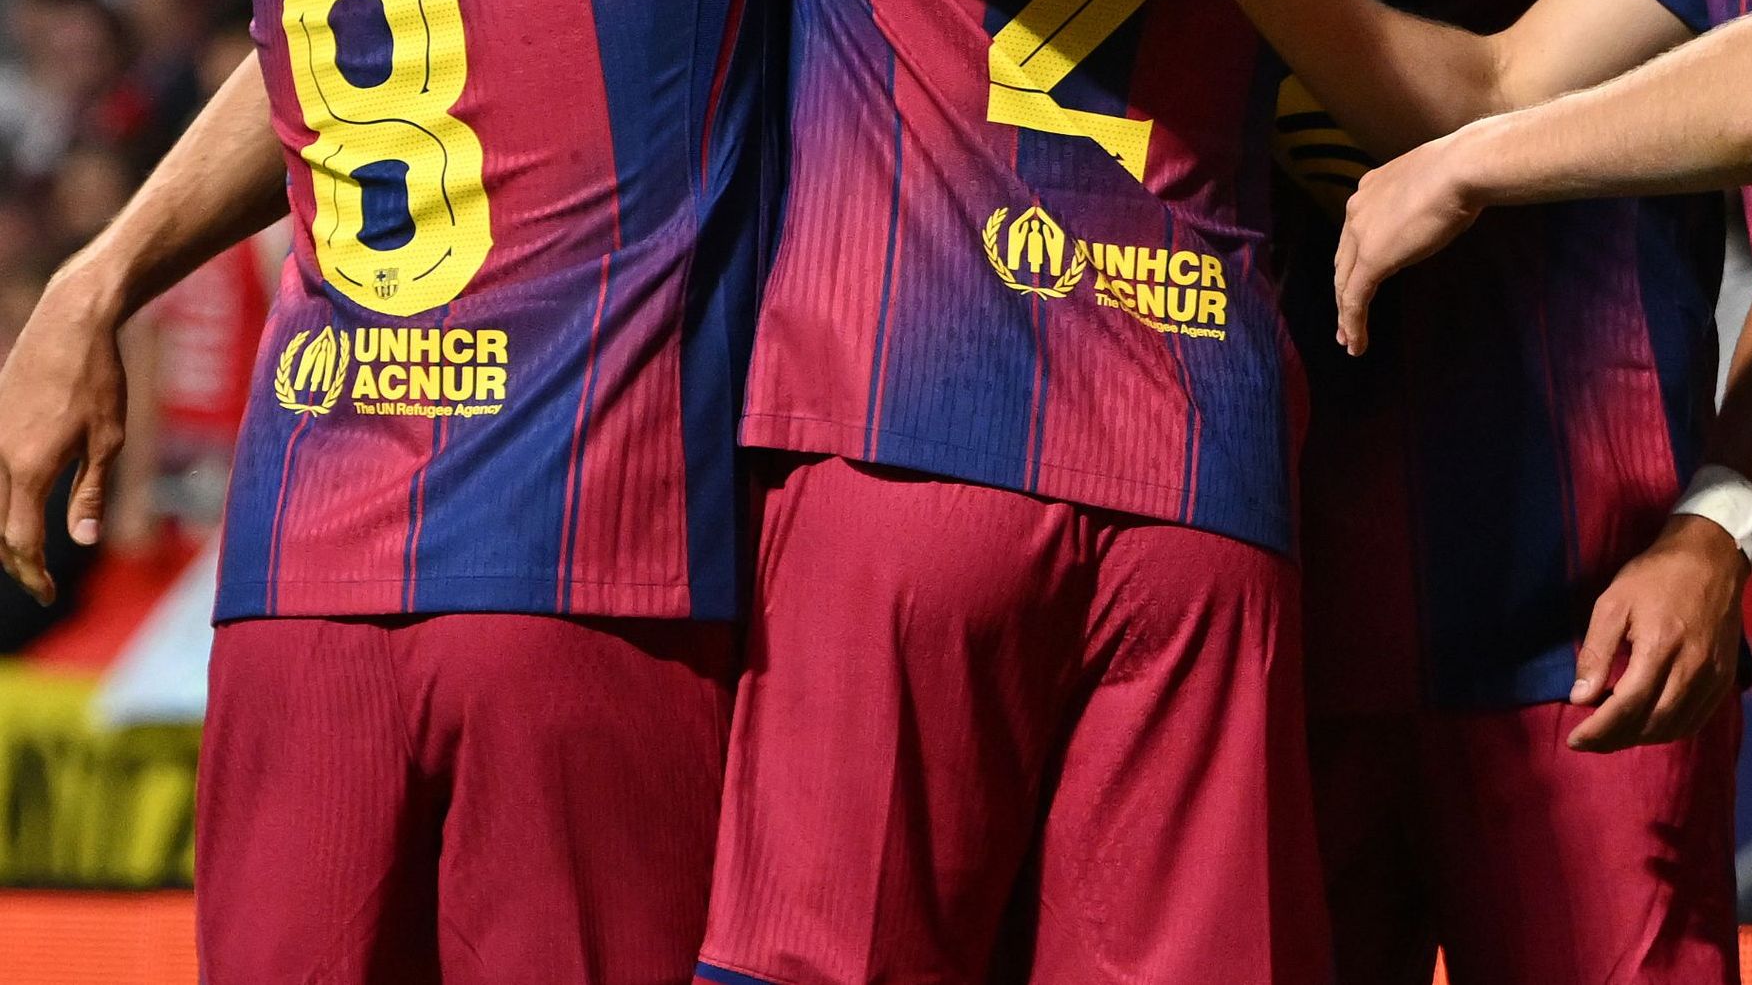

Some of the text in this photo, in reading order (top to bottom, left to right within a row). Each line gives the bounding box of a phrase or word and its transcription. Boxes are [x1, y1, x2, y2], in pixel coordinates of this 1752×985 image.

[1078, 239, 1226, 289] UNHCR
[1095, 293, 1119, 308] The
[1180, 323, 1226, 341] Agency
[354, 327, 509, 364] UNHCR
[351, 364, 508, 401] ACNUR
[353, 402, 503, 419] The UN Refugee Agency
